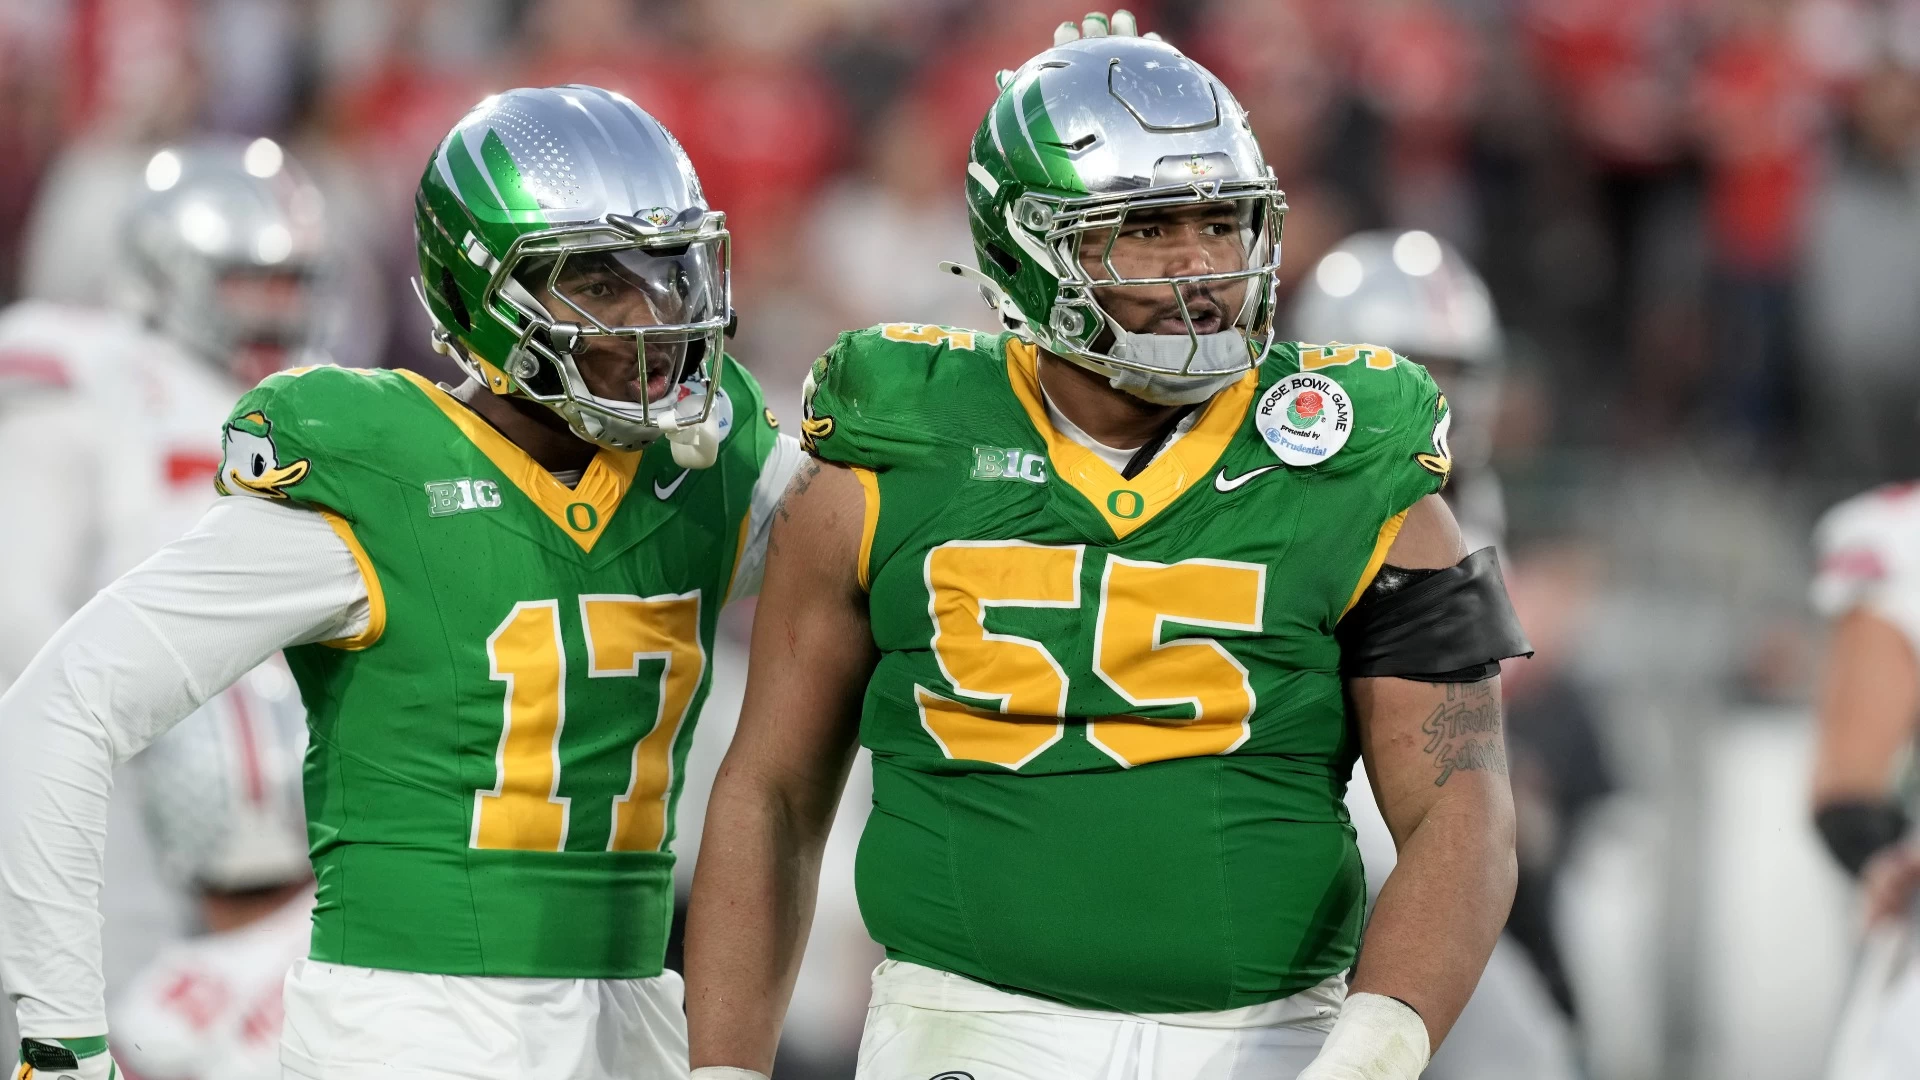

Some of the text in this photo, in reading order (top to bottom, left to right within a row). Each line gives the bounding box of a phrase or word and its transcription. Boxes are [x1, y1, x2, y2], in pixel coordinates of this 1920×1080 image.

[1261, 377, 1348, 433] ROSE BOWL GAME
[1280, 424, 1321, 440] presented by
[1280, 437, 1328, 457] Prudential
[565, 502, 599, 533] O
[1106, 489, 1145, 520] O
[914, 539, 1267, 770] 55
[469, 589, 706, 852] 17
